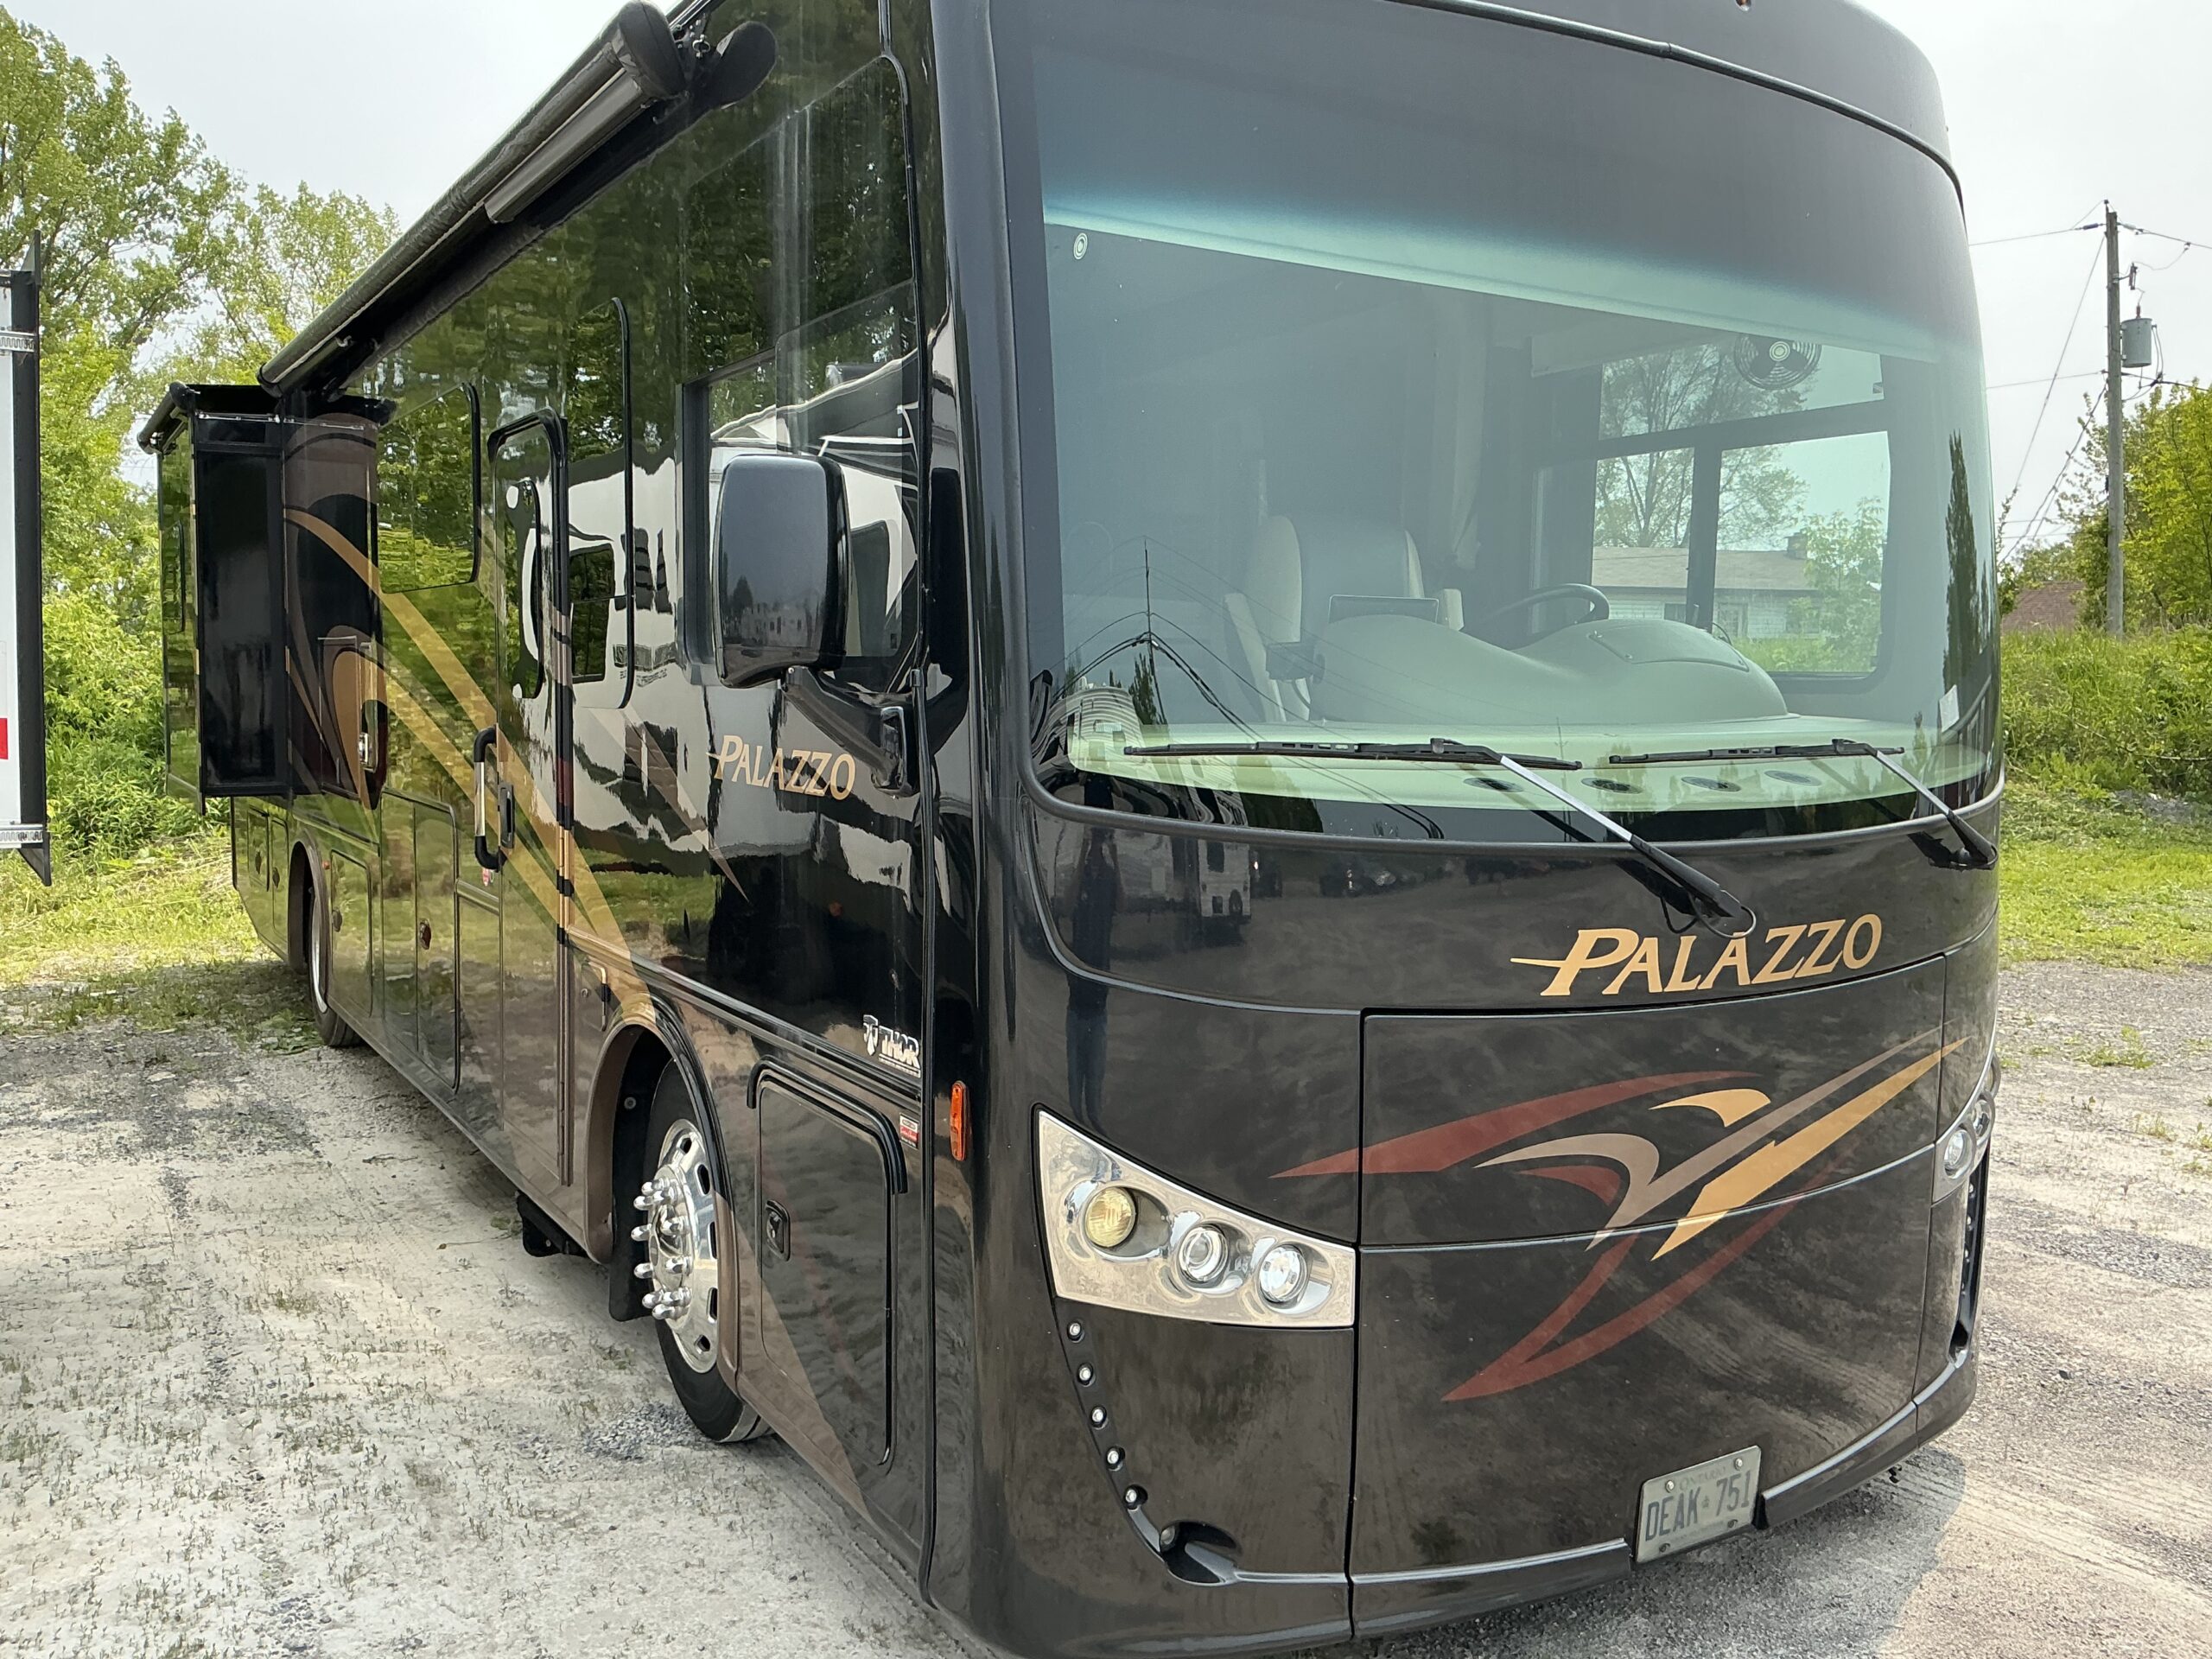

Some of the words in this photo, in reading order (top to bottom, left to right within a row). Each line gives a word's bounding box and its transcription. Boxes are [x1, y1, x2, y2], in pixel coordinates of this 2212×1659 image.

[706, 735, 856, 800] PALAZZO
[1510, 913, 1882, 996] PALAZZO
[879, 1025, 921, 1069] THOR
[1645, 1486, 1700, 1541] DEAK
[1716, 1471, 1751, 1516] 751
